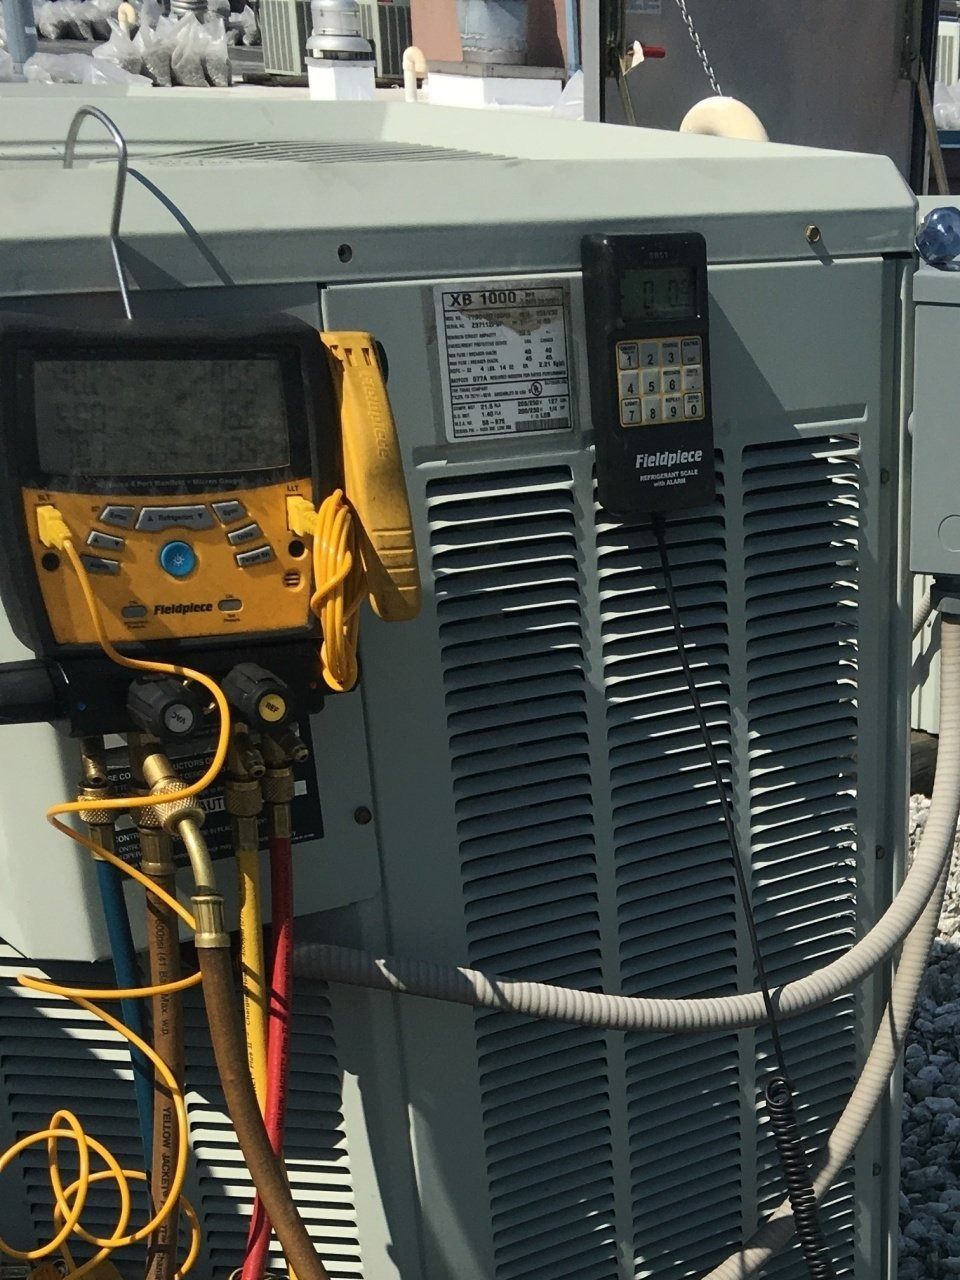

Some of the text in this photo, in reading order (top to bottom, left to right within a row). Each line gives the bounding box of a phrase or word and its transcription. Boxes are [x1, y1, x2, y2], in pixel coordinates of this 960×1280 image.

[450, 291, 517, 307] XB 1000
[627, 355, 632, 366] 1
[647, 354, 654, 365] 2
[668, 352, 674, 363] 3
[627, 379, 676, 394] 4 5 6
[629, 404, 697, 421] 7 8 9 0
[635, 450, 703, 469] Fieldpiece
[639, 469, 699, 482] REFRIGERANT SCALE
[653, 478, 686, 487] with ALARM
[153, 602, 213, 615] Fieldpiece
[265, 701, 280, 714] REF
[171, 711, 186, 725] VAC
[161, 1106, 172, 1154] YELLOW
